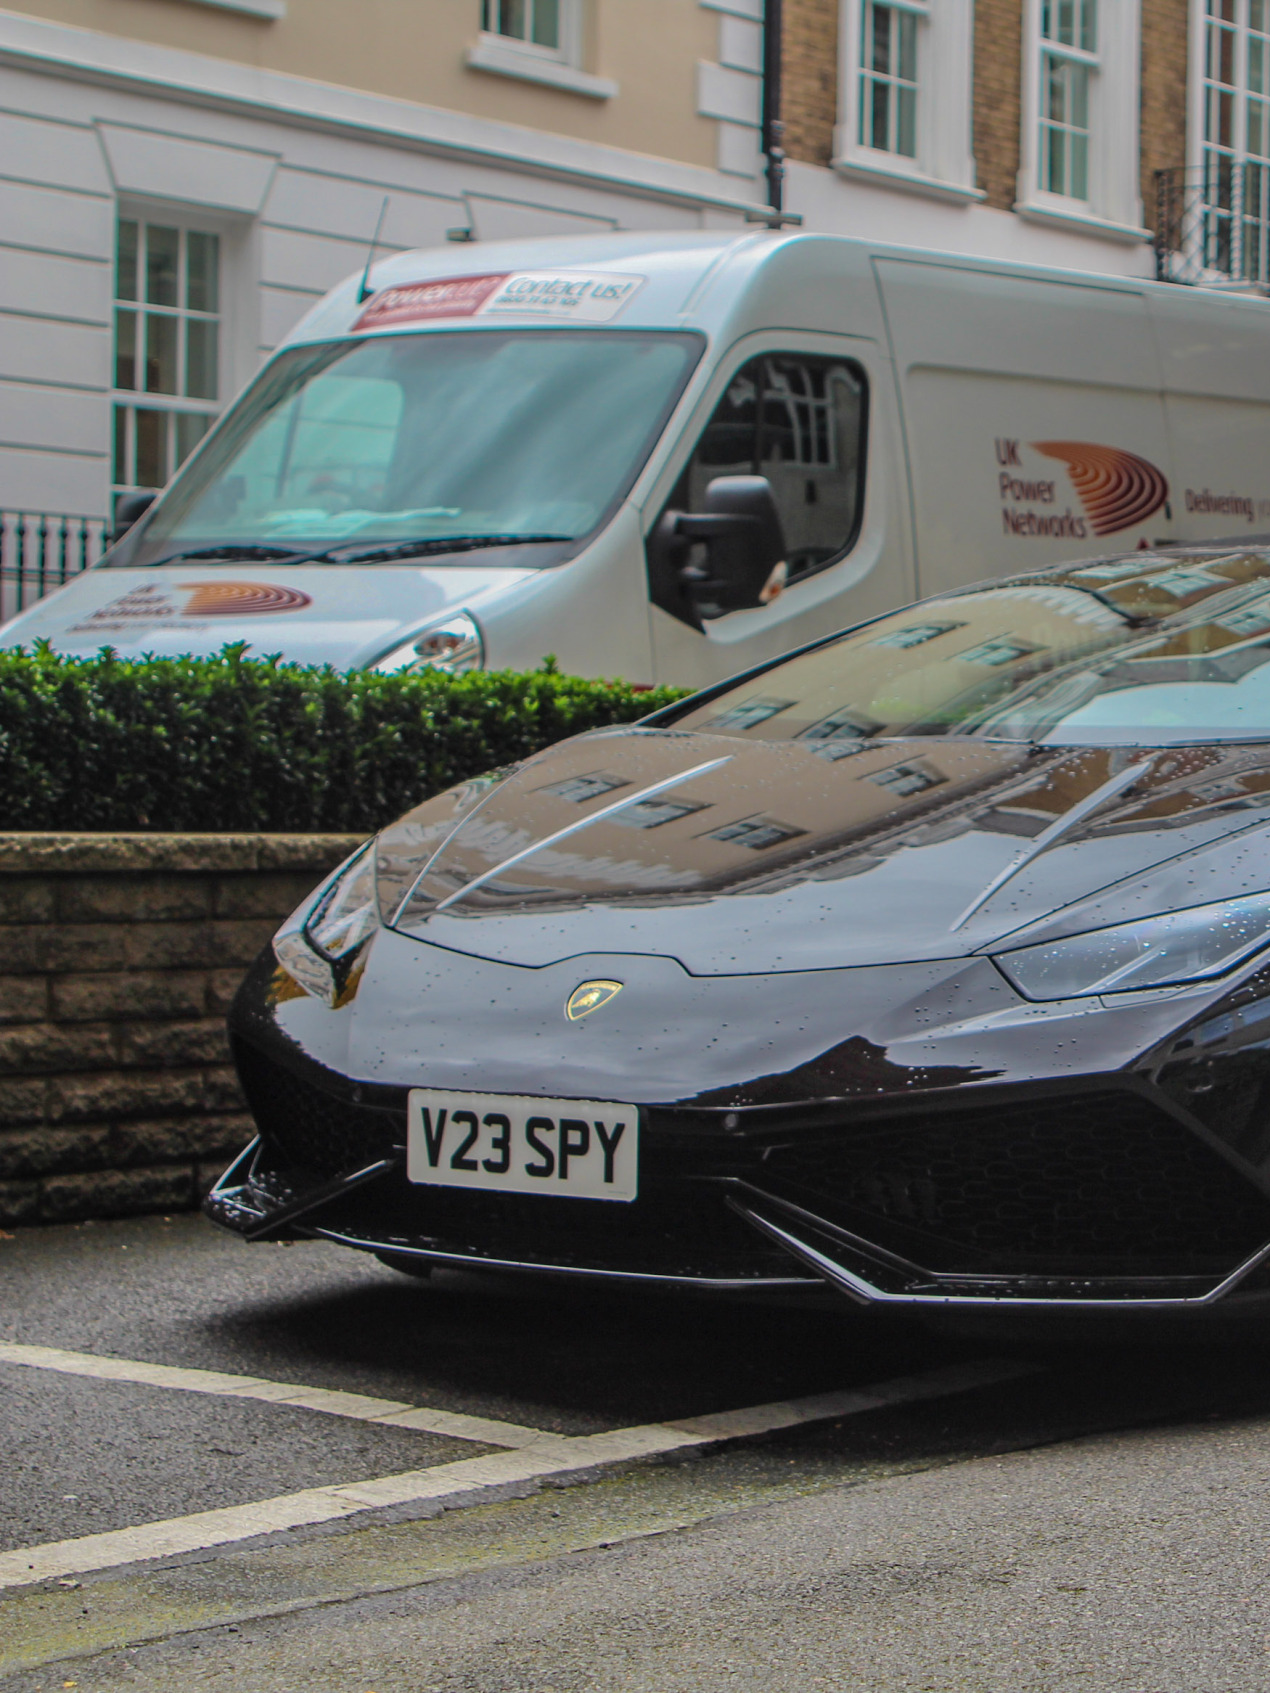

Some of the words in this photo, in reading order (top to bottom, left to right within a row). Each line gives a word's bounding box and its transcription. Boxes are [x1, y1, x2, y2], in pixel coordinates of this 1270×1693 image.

[505, 277, 592, 296] Contact
[590, 282, 632, 299] us!
[994, 437, 1022, 466] UK
[999, 471, 1055, 503] Power
[1002, 507, 1086, 539] Networks
[421, 1107, 511, 1174] V23
[525, 1116, 625, 1183] SPY
